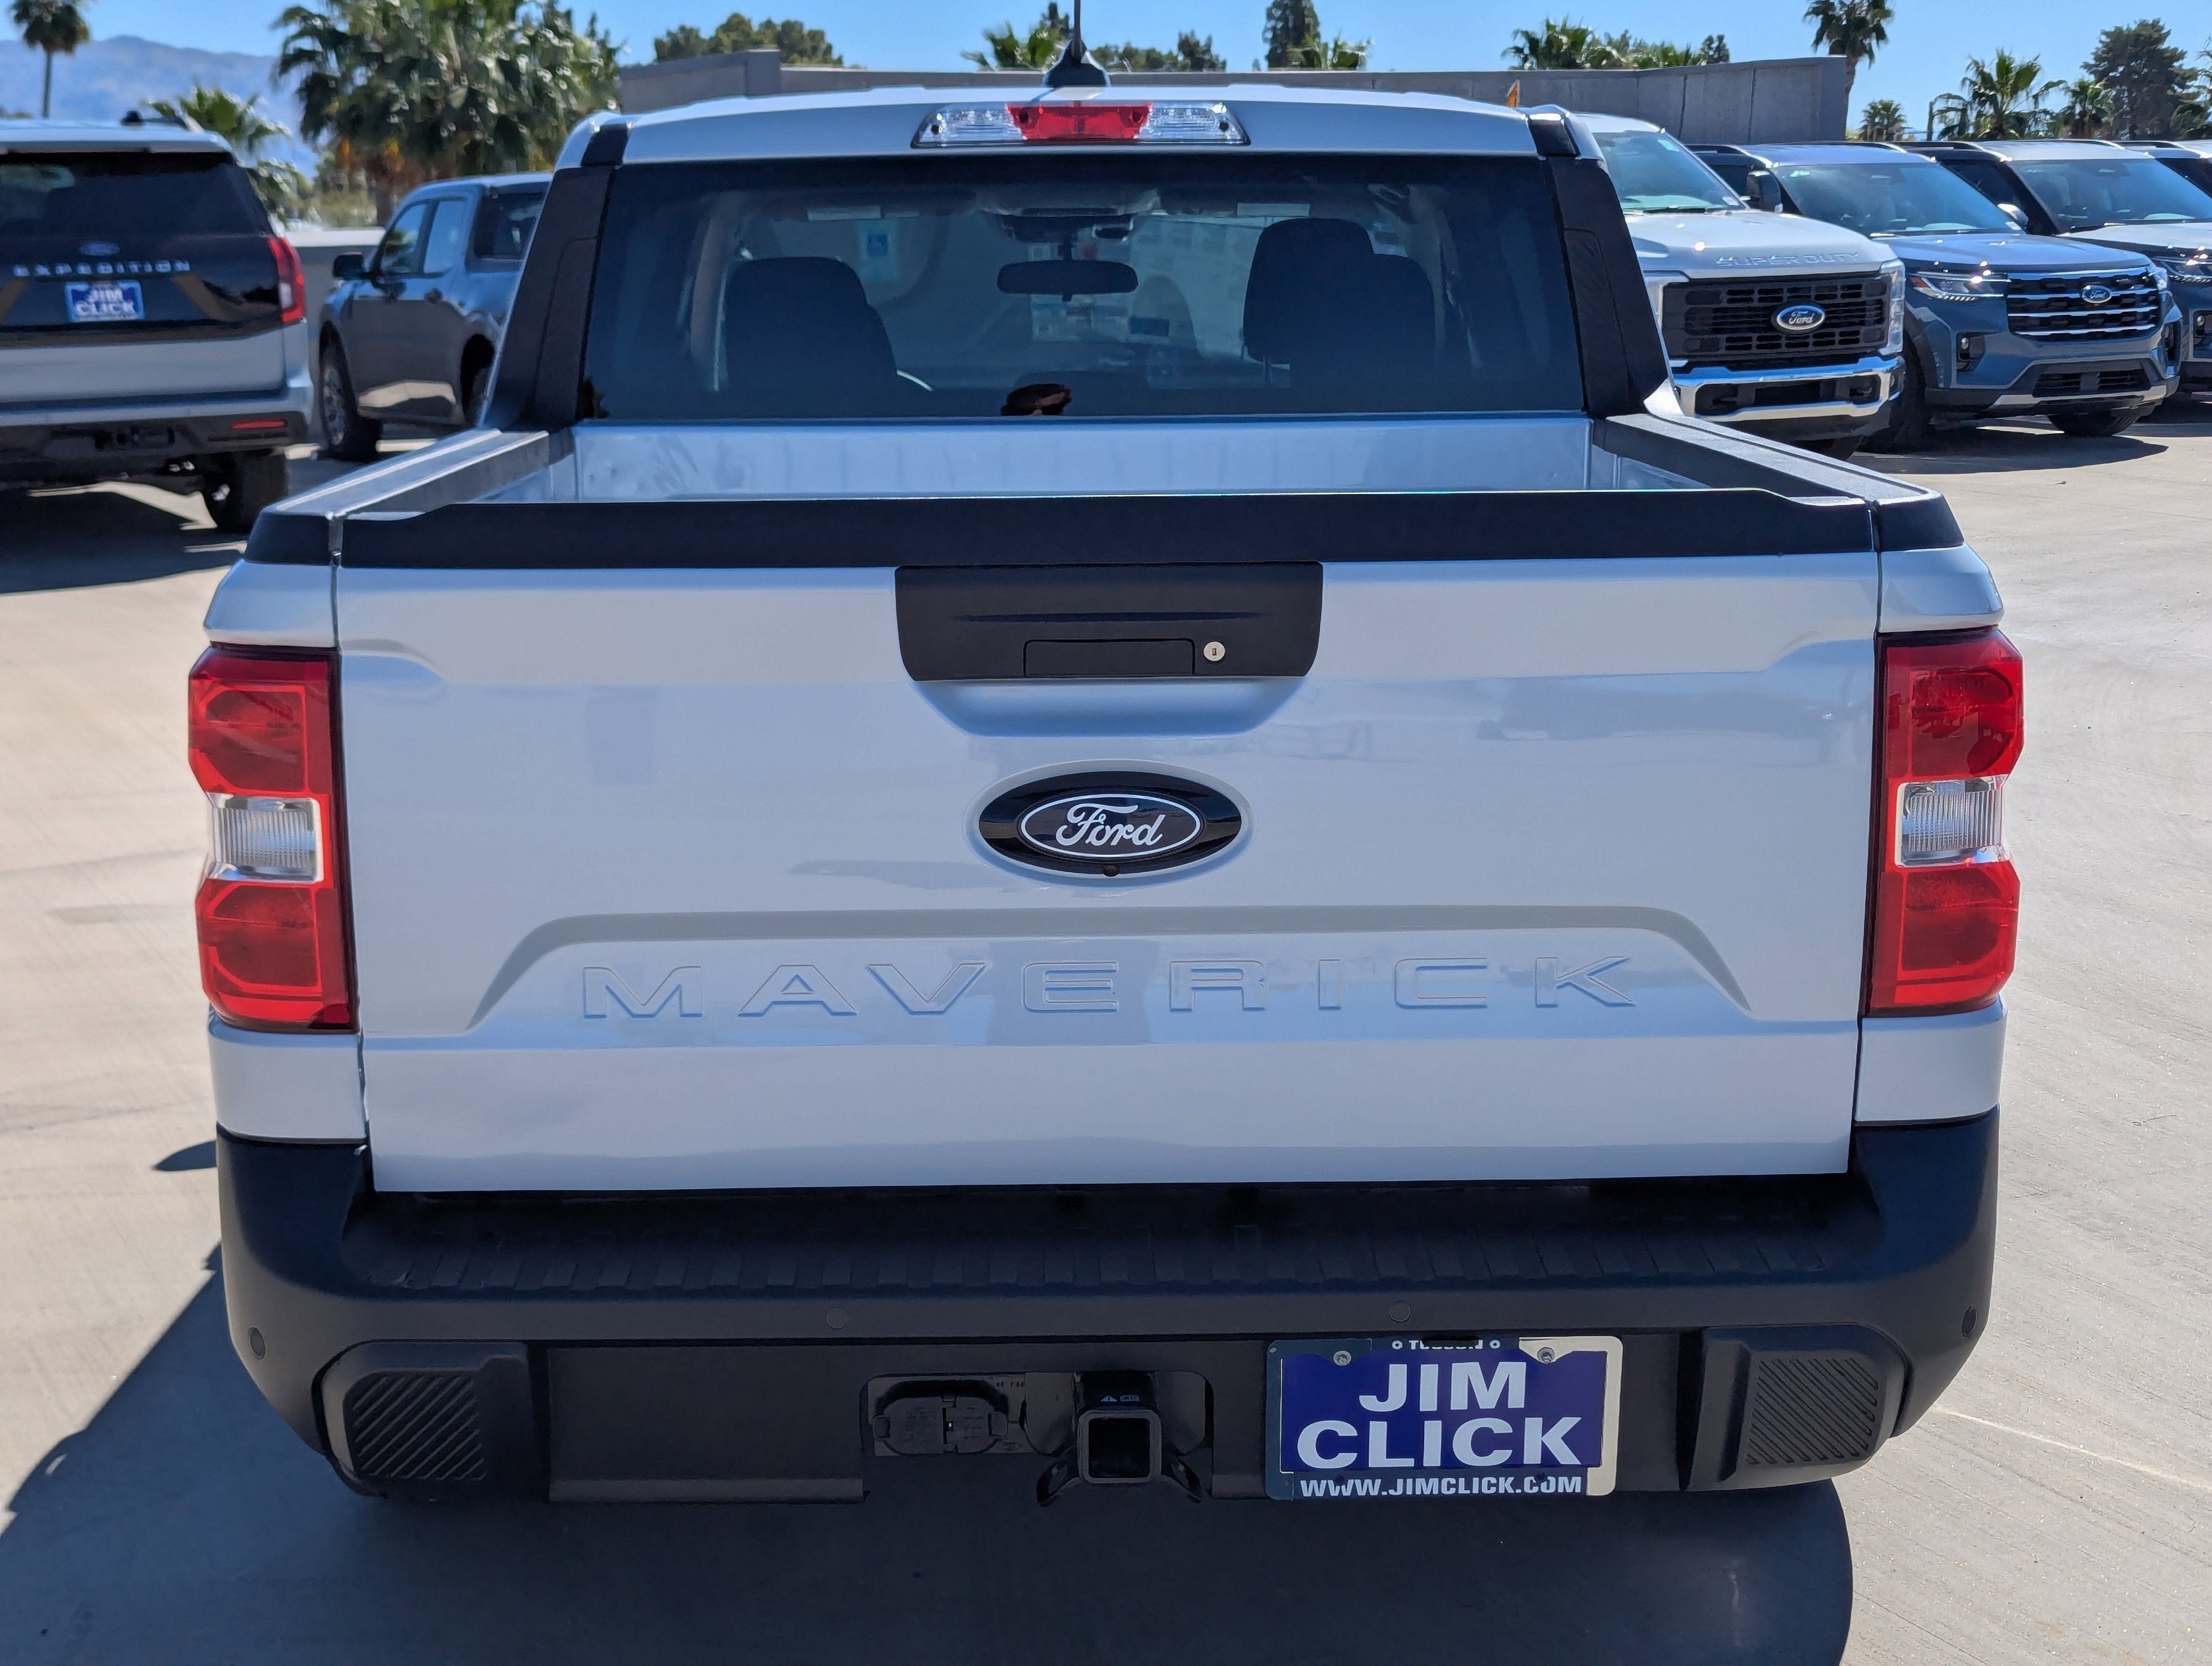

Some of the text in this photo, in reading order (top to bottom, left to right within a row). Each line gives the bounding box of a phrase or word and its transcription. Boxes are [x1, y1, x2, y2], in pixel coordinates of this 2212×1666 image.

[13, 260, 191, 277] EXPEDITION
[1716, 252, 1859, 266] SUPER DUTY
[87, 287, 124, 302] JIM
[75, 301, 136, 316] CLICK
[1789, 311, 1815, 325] Ford
[1056, 803, 1166, 846] Ford
[582, 956, 1637, 1018] MAVERICK
[1359, 1361, 1527, 1412] JIM
[1297, 1417, 1582, 1469] CLICK
[1301, 1476, 1581, 1497] WWW.JIMCLICK.COM
